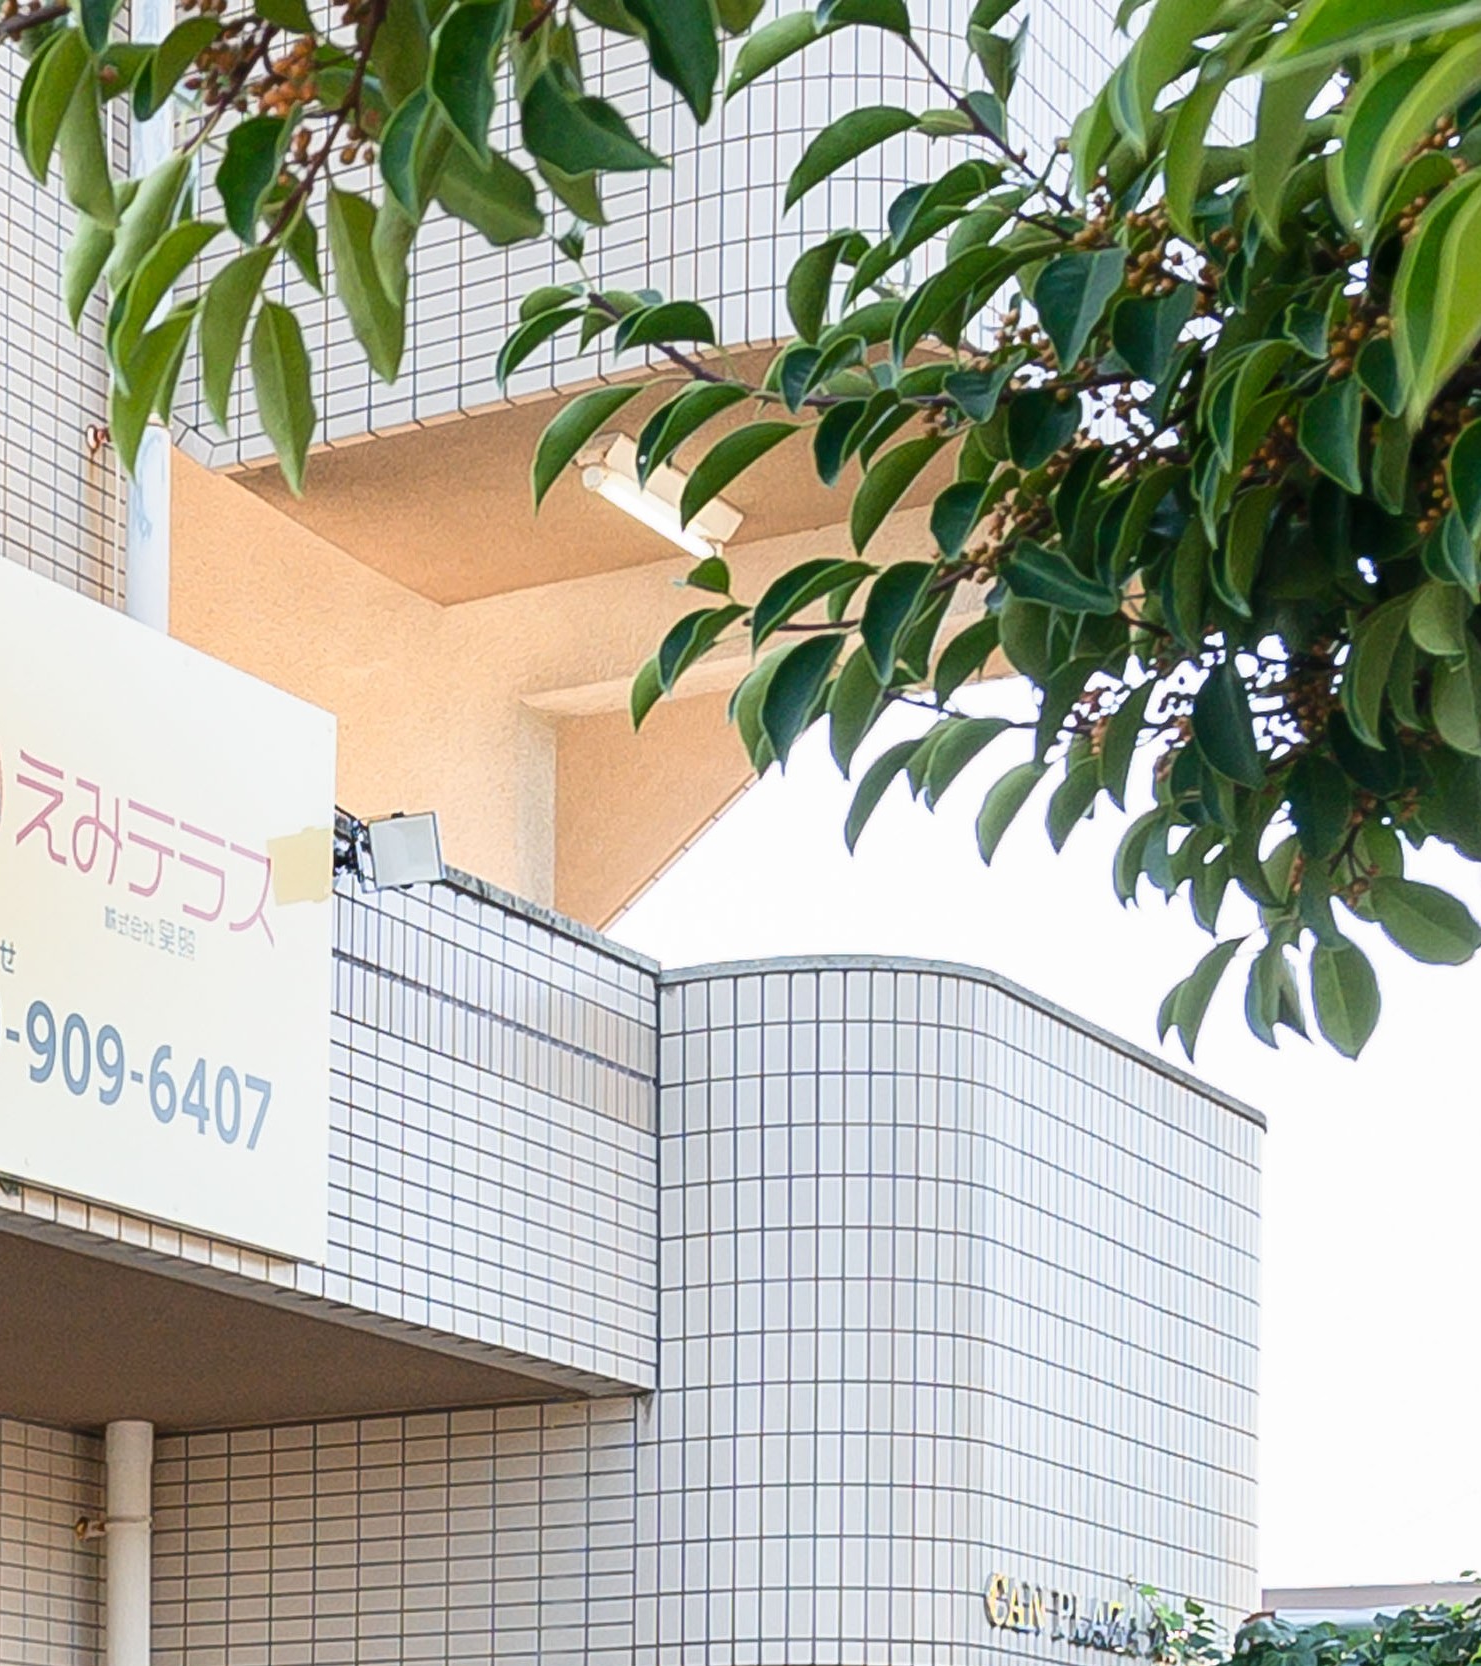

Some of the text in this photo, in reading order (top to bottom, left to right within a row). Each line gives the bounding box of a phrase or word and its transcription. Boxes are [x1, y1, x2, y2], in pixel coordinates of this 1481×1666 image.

[15, 749, 275, 948] えみテラス
